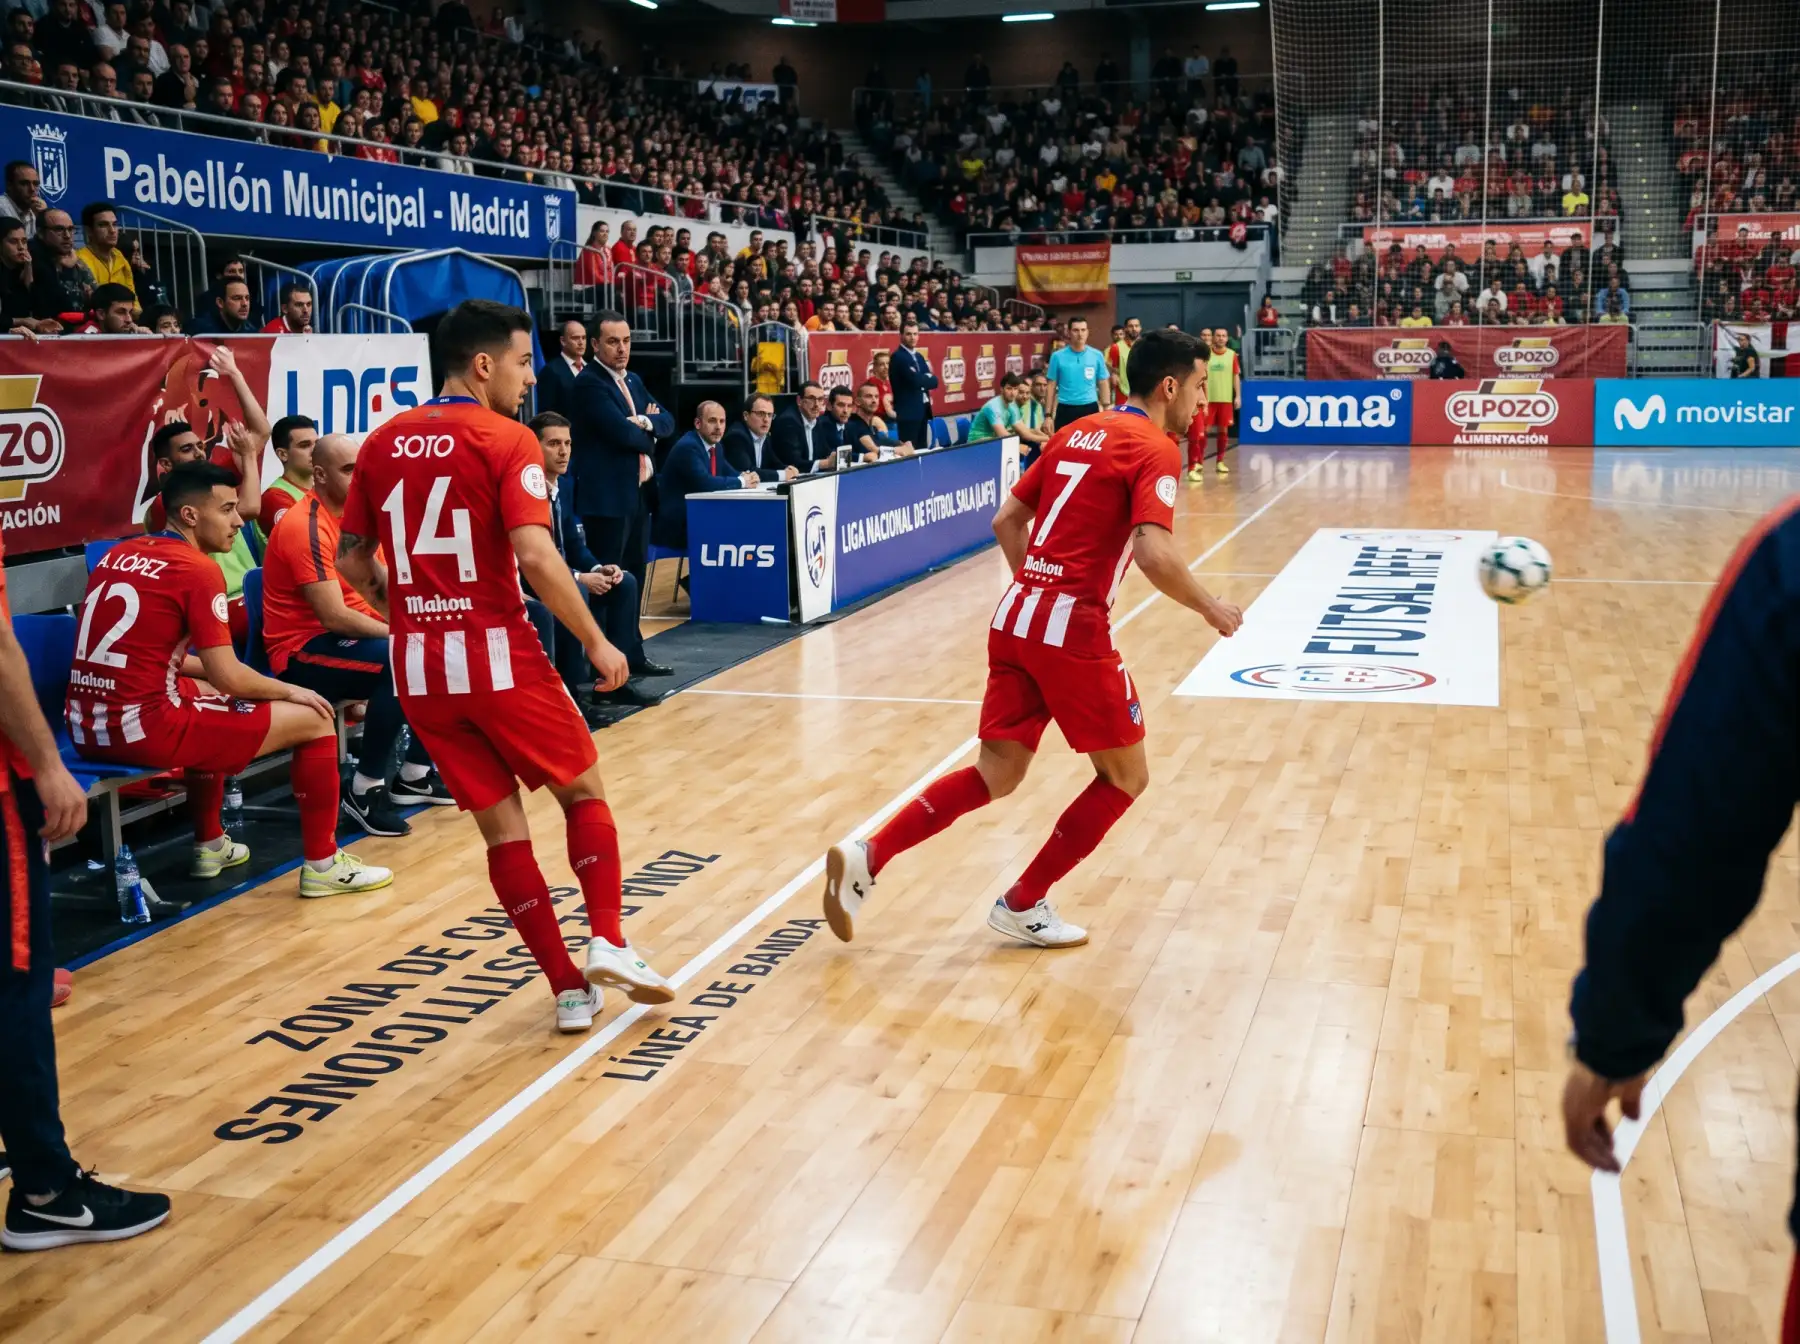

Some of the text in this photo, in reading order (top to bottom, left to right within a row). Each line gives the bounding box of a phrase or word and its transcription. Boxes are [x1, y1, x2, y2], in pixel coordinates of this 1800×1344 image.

[104, 147, 271, 214] Pabellón
[283, 170, 426, 236] Municipal
[450, 190, 530, 239] Madrid
[1676, 401, 1795, 423] movistar
[391, 434, 455, 458] SOTO
[1066, 429, 1108, 451] RAÚL
[1453, 433, 1549, 444] ALIMENTACIÓN
[841, 519, 867, 553] LIGA
[866, 505, 914, 544] NACIONAL
[913, 501, 926, 529] DE
[925, 490, 956, 525] FÚTBOL
[955, 485, 976, 514] SALA
[1034, 460, 1092, 547] 7
[381, 476, 478, 584] 14
[97, 552, 169, 580] A. LÓPEZ
[1023, 554, 1064, 577] Mahou
[76, 580, 140, 669] 12
[405, 594, 473, 614] Mahou
[1303, 583, 1436, 657] FUTSAL
[71, 668, 116, 691] Mahou
[620, 849, 722, 897] ZONA
[244, 983, 420, 1052] ZONA
[376, 944, 479, 976] DE
[601, 918, 828, 1082] LÍNEA DE BANDA
